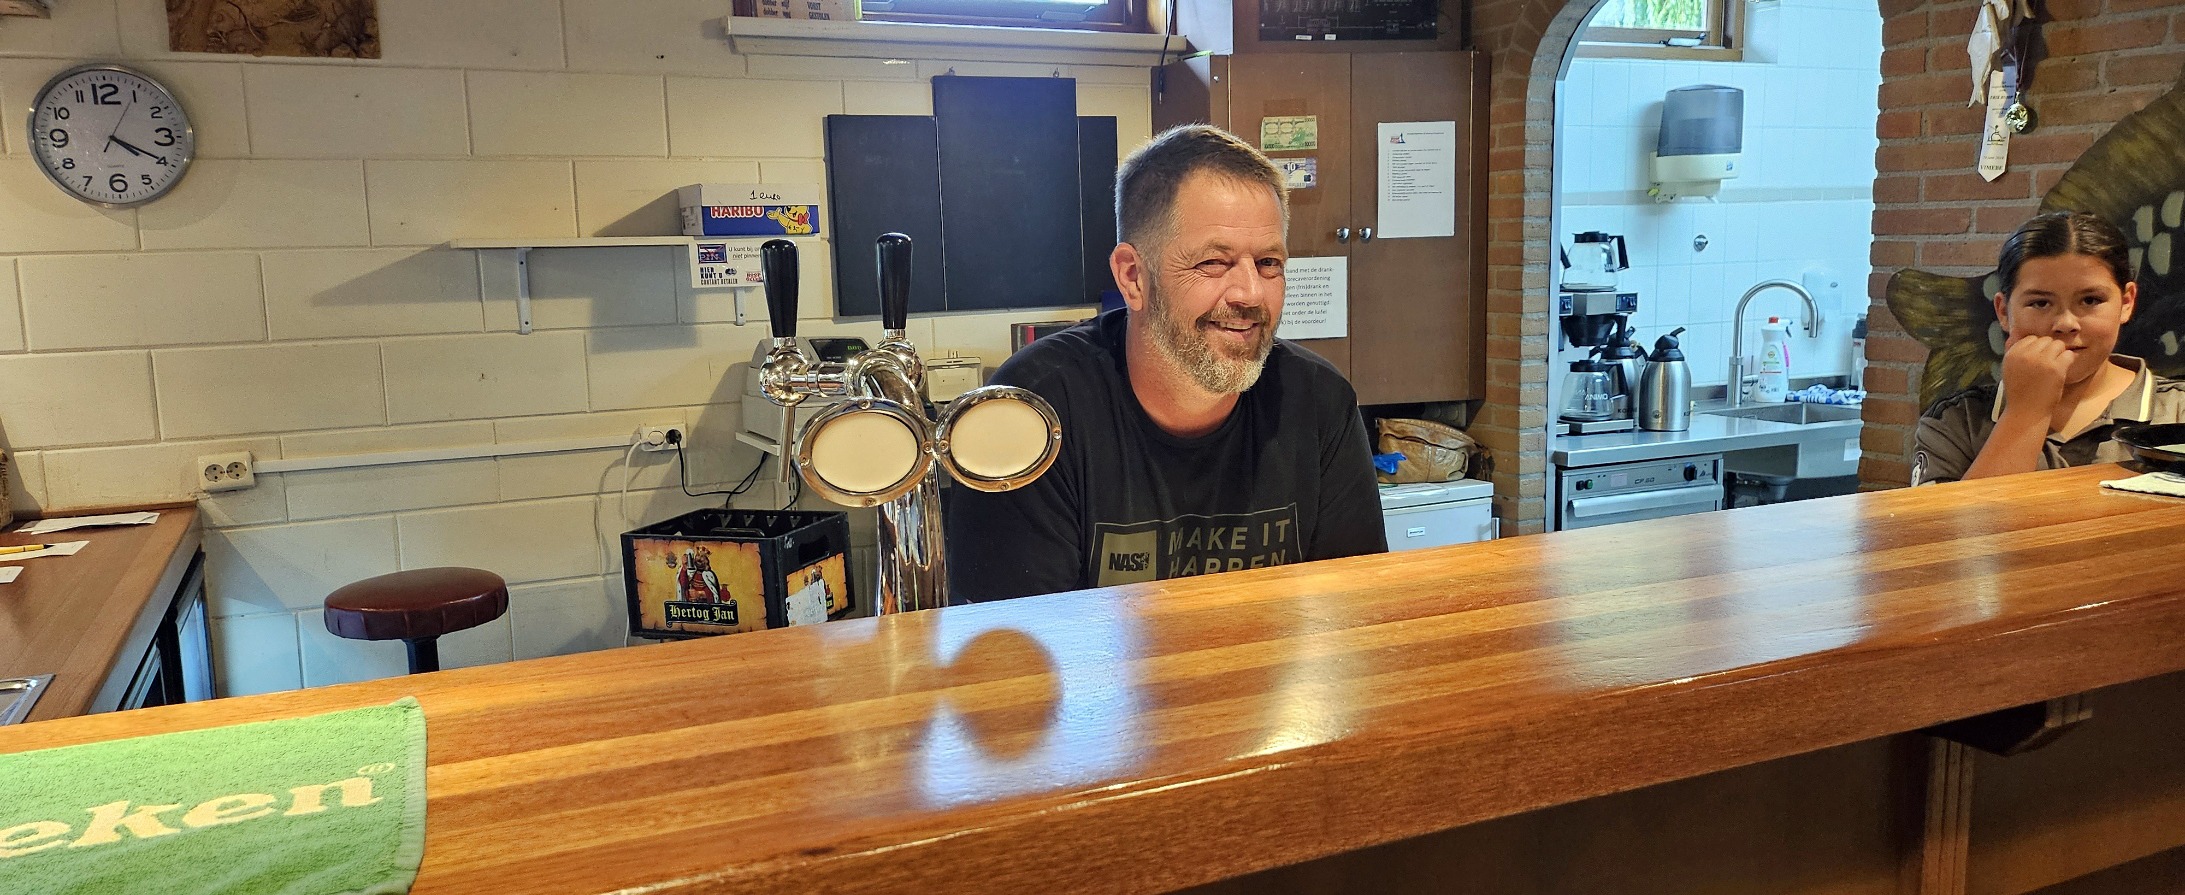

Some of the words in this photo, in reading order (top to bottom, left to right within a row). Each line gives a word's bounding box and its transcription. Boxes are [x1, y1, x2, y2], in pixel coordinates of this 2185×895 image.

[75, 90, 85, 103] 11
[91, 83, 121, 105] 12
[133, 90, 137, 103] 1
[54, 107, 70, 120] 10
[150, 107, 163, 119] 2
[49, 128, 69, 148] 9
[154, 127, 175, 147] 3
[62, 157, 76, 170] 8
[156, 157, 169, 167] 4
[1287, 162, 1296, 171] 10
[83, 175, 93, 187] 7
[109, 173, 128, 193] 6
[141, 174, 152, 186] 5
[750, 189, 757, 200] 1
[711, 206, 763, 217] HARIBO
[1168, 526, 1248, 555] MAKE
[1262, 518, 1290, 546] IT
[669, 604, 710, 621] Hertog
[713, 606, 735, 621] Jan
